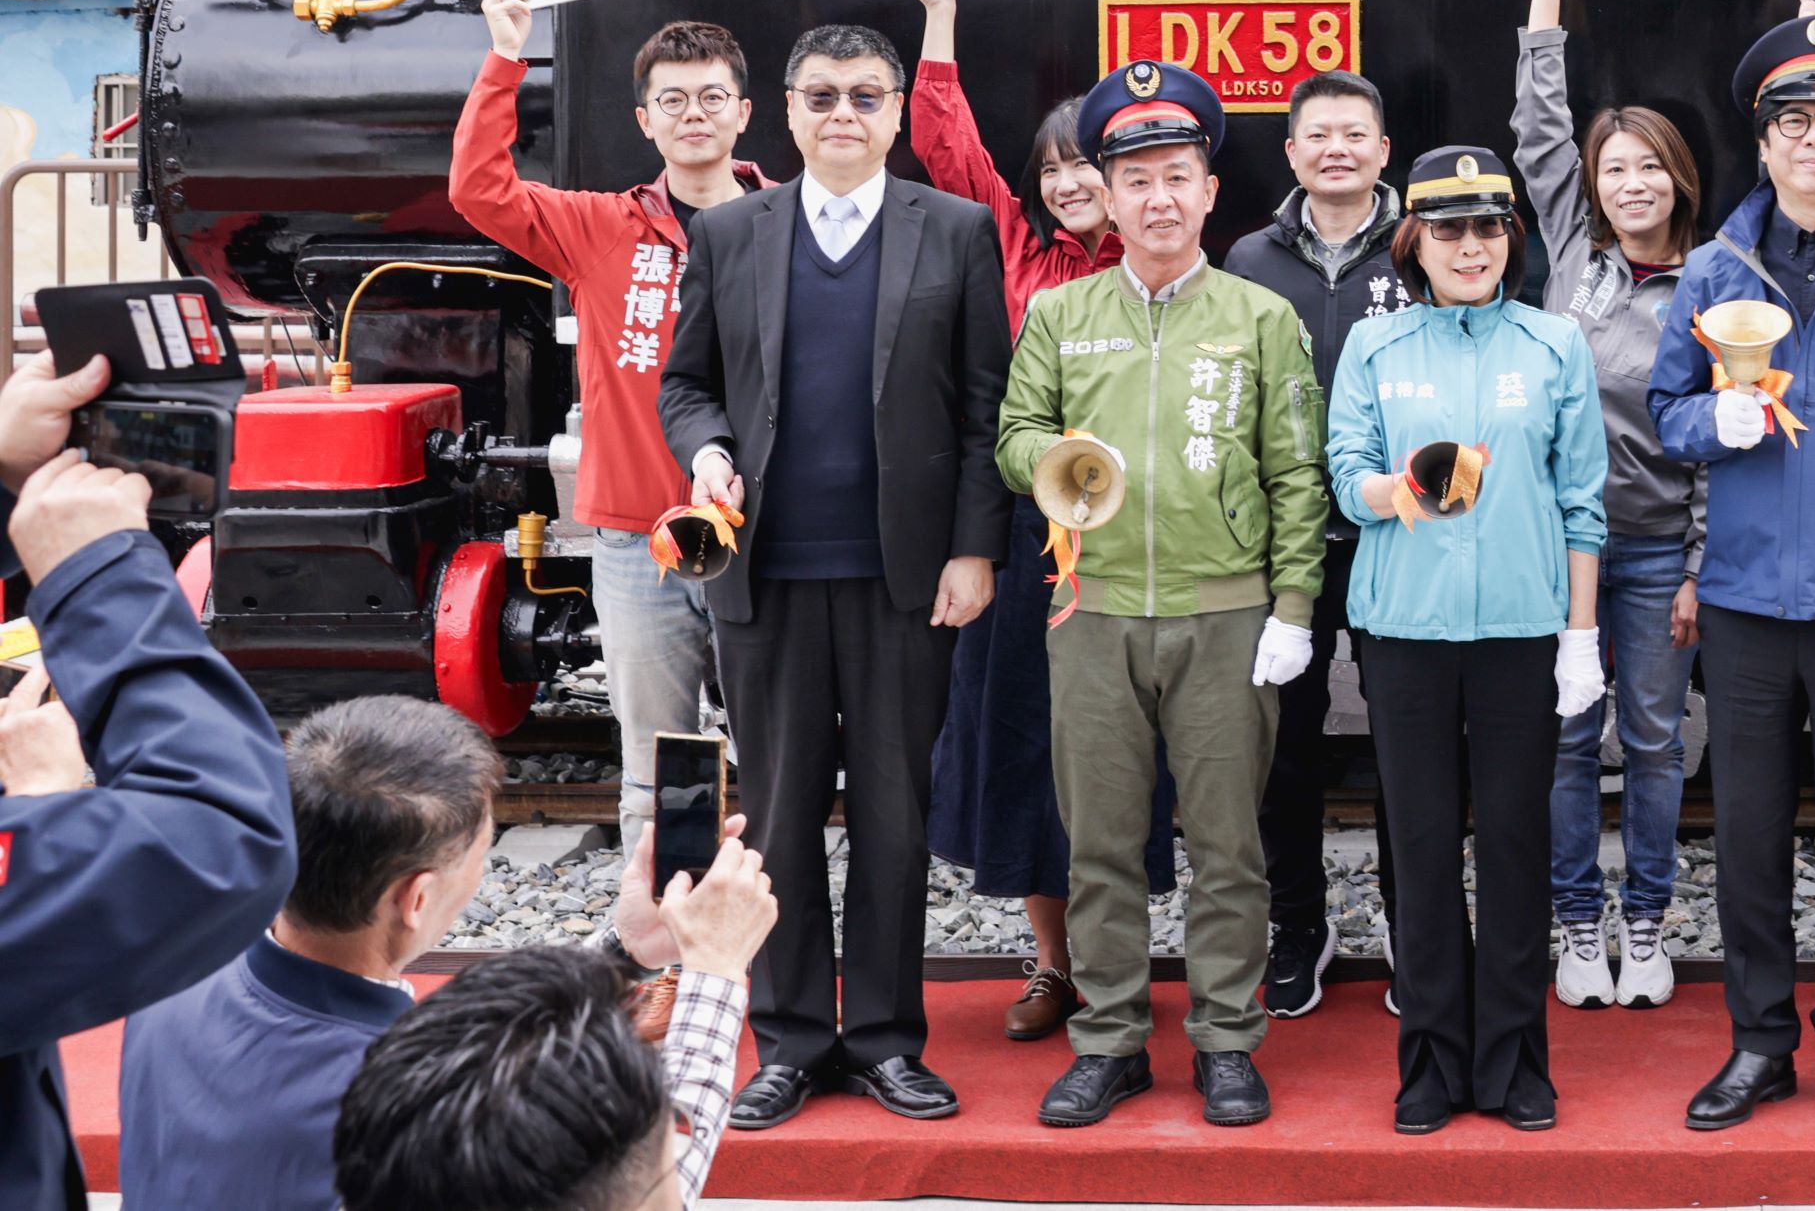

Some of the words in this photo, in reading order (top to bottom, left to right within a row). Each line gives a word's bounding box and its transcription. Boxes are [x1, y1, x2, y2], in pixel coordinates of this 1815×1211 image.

[1260, 10, 1345, 73] 58
[1221, 80, 1284, 96] LDK50
[616, 242, 674, 373] 張博洋
[1183, 357, 1222, 472] 許智傑
